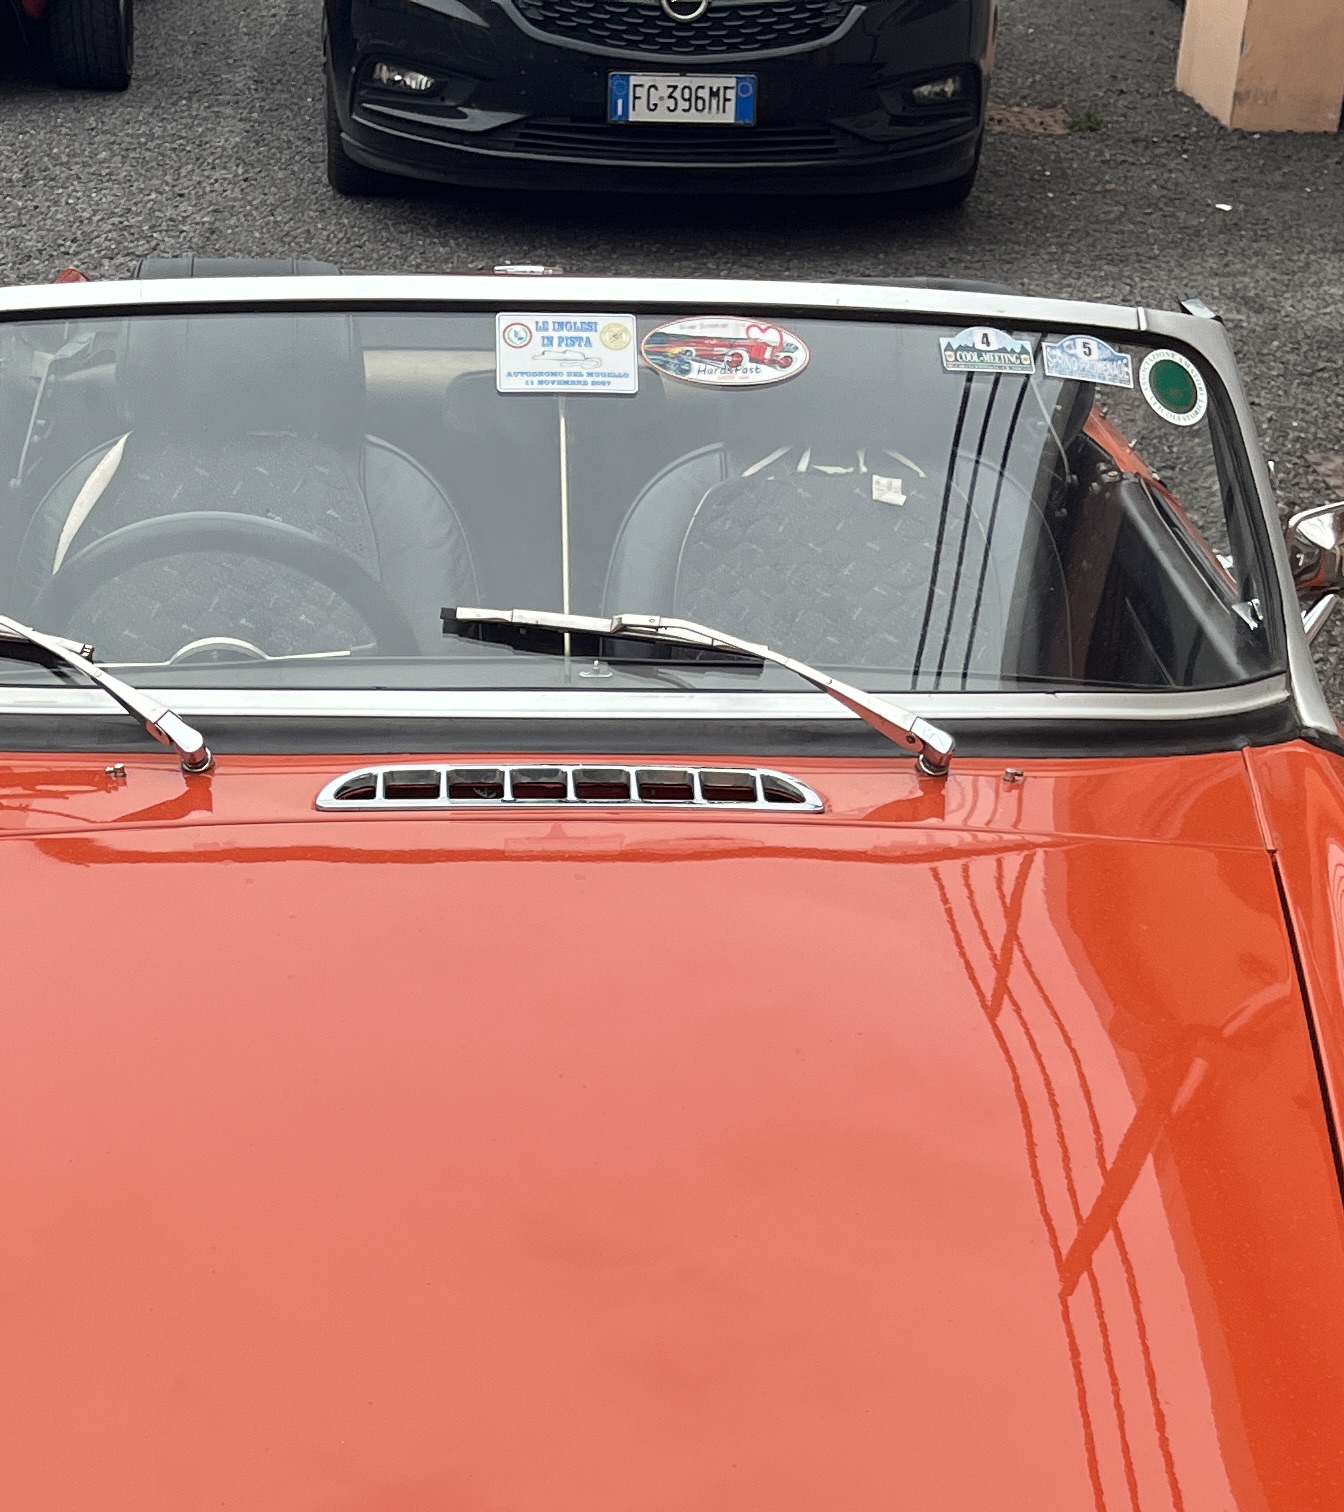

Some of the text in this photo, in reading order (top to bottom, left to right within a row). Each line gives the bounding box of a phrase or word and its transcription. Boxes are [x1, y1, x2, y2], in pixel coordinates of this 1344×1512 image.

[617, 83, 736, 115] I FG 396MF
[535, 320, 598, 332] LE INGLESI
[541, 336, 593, 348] IN PISTA
[981, 332, 991, 347] 4
[1082, 341, 1093, 357] 5
[957, 351, 1021, 365] COOL-MEETING
